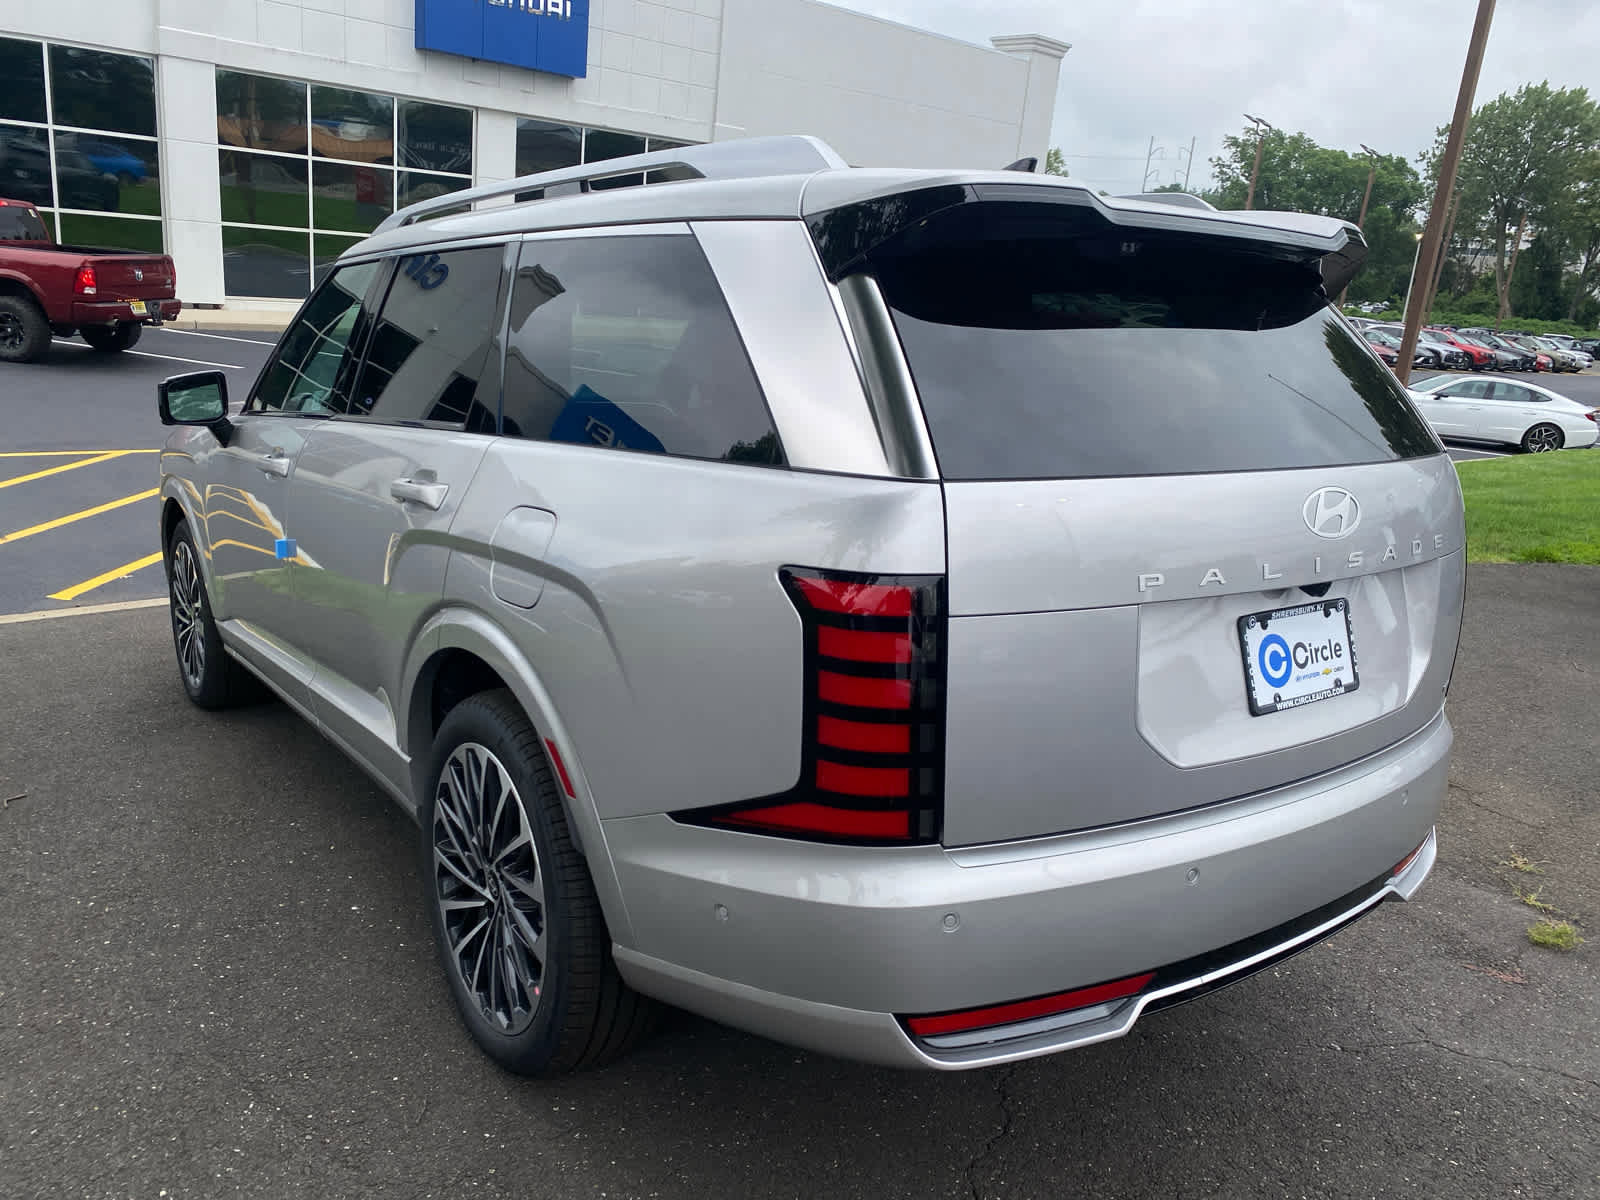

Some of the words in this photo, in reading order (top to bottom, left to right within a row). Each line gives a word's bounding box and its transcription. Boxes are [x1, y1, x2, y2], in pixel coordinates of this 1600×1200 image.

[1138, 535, 1444, 592] PALISADE
[1293, 639, 1342, 669] Circle
[1276, 687, 1345, 711] WWW.CIRCLEAUTO.COM
